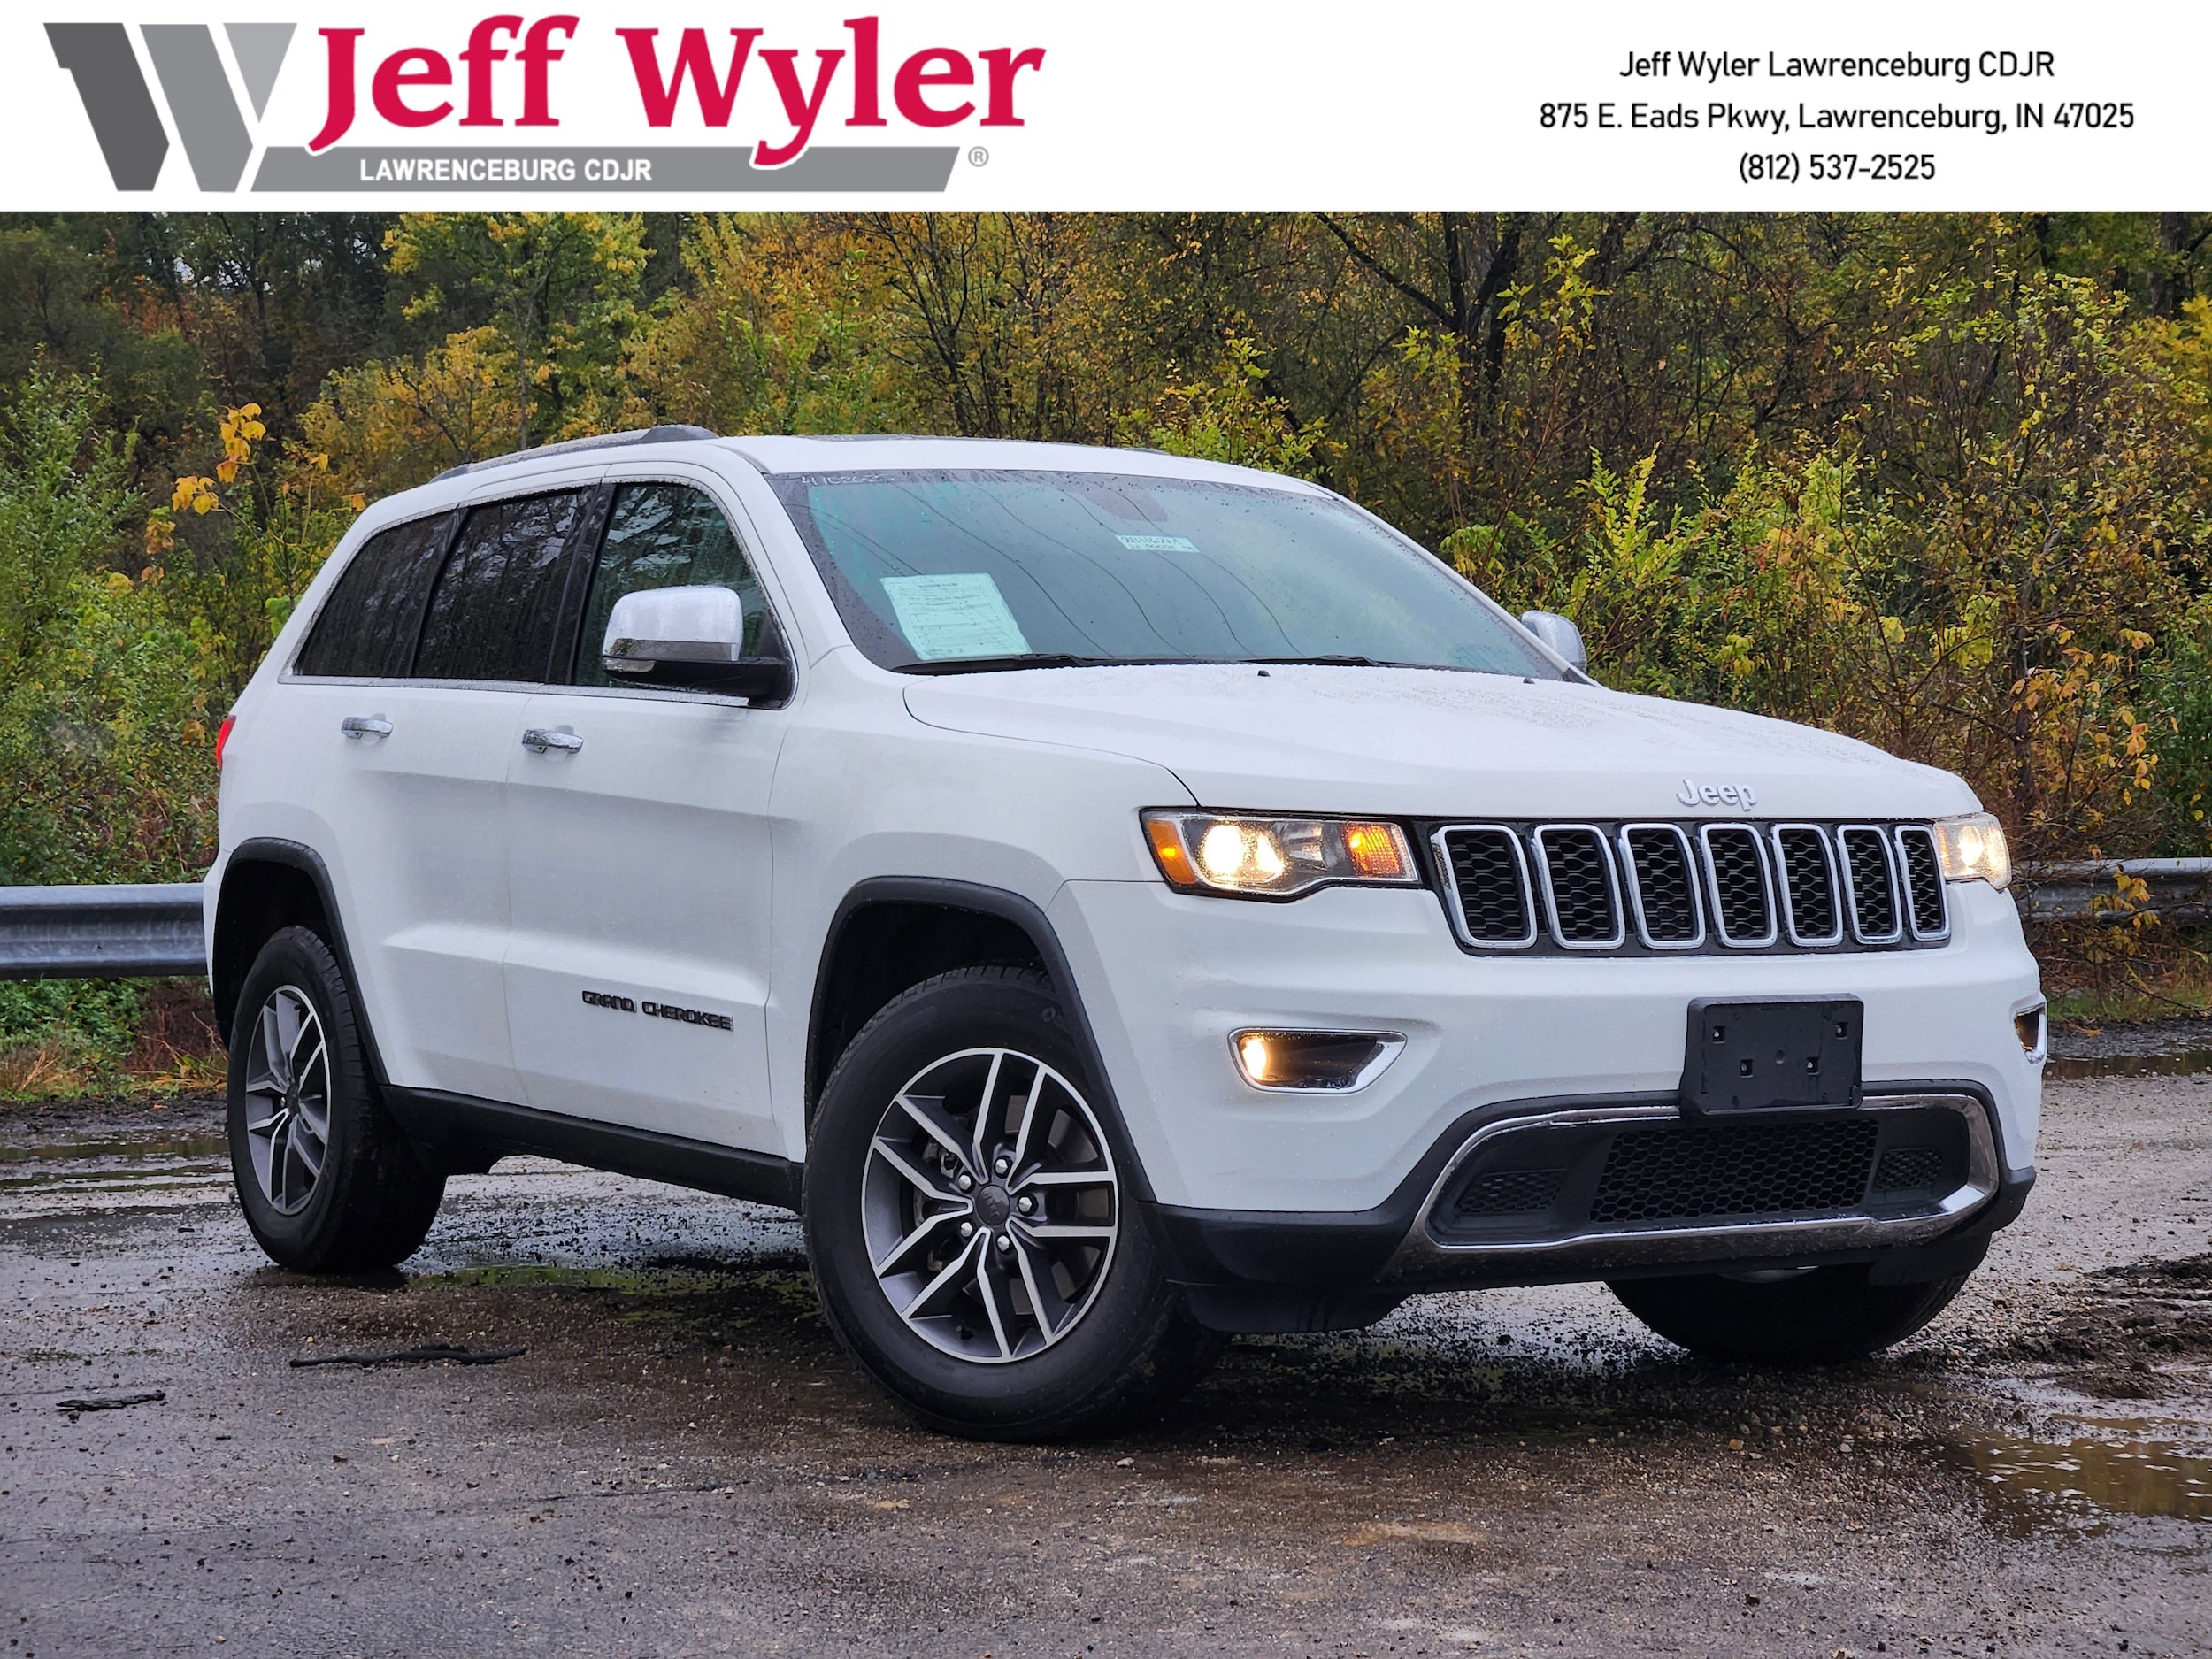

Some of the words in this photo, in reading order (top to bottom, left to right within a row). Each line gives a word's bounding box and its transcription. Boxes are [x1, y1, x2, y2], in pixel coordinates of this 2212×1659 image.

[1676, 778, 1758, 812] Jeep
[581, 990, 637, 1014] GRAND
[641, 1001, 734, 1032] CHEROKEE
